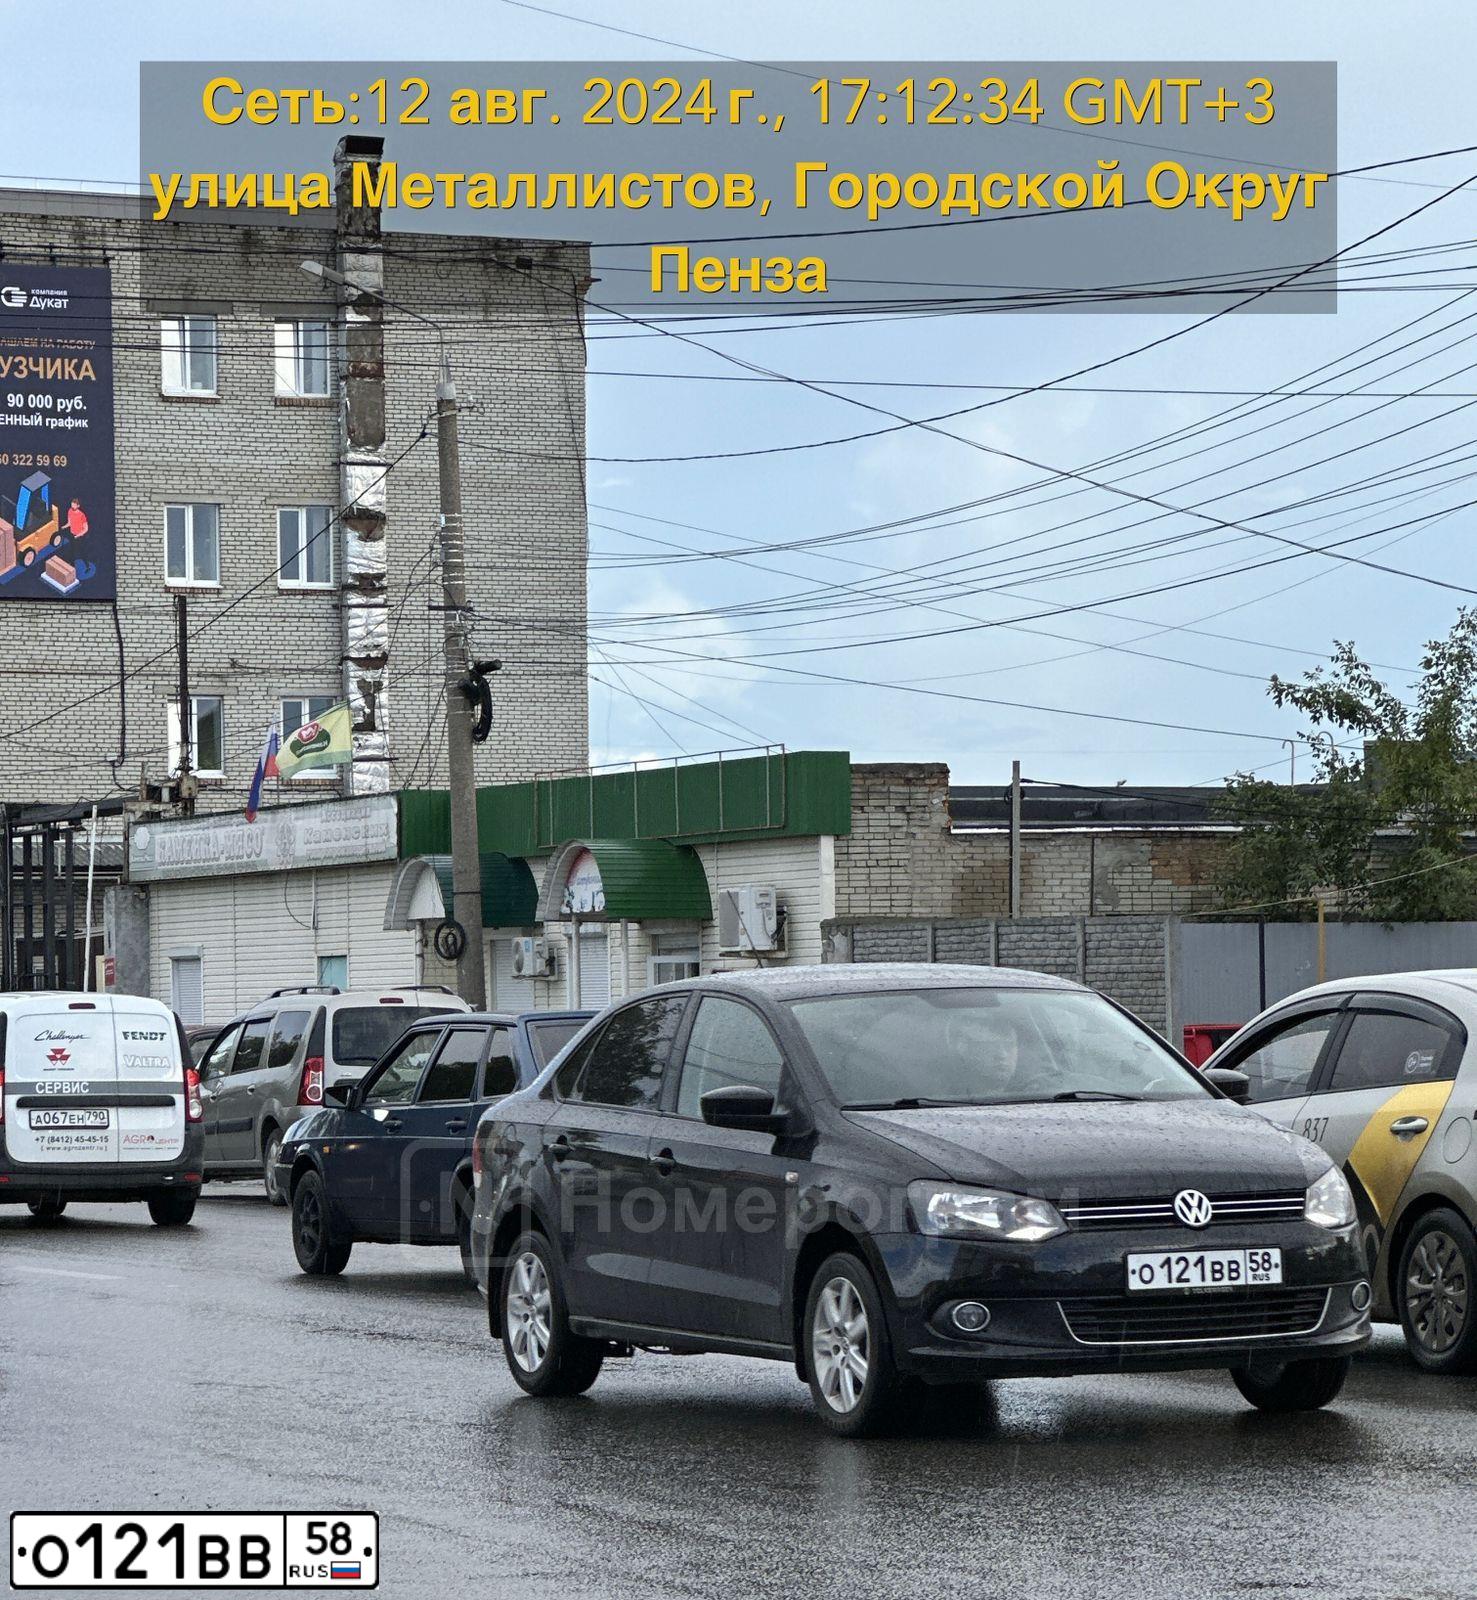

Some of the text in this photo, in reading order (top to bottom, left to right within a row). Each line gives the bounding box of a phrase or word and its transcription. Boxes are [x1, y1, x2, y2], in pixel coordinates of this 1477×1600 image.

[28, 295, 69, 310] Дукат
[0, 355, 97, 381] УЗЧИКА
[7, 393, 87, 413] 90 000 руб.
[0, 412, 89, 430] ЕННЫЙ график
[12, 453, 33, 466] 322
[36, 454, 50, 467] 59
[53, 455, 67, 467] 69
[33, 1029, 91, 1043] Challenger
[122, 1030, 167, 1042] FENDT
[123, 1054, 170, 1068] VALTRA
[35, 1082, 90, 1094] СЕРВИС
[1302, 1116, 1330, 1143] 837
[47, 1135, 73, 1145] (8412)
[74, 1136, 109, 1144] 45-45-15
[1138, 1251, 1273, 1285] О121ВВ 58
[1252, 1273, 1271, 1282] RUS
